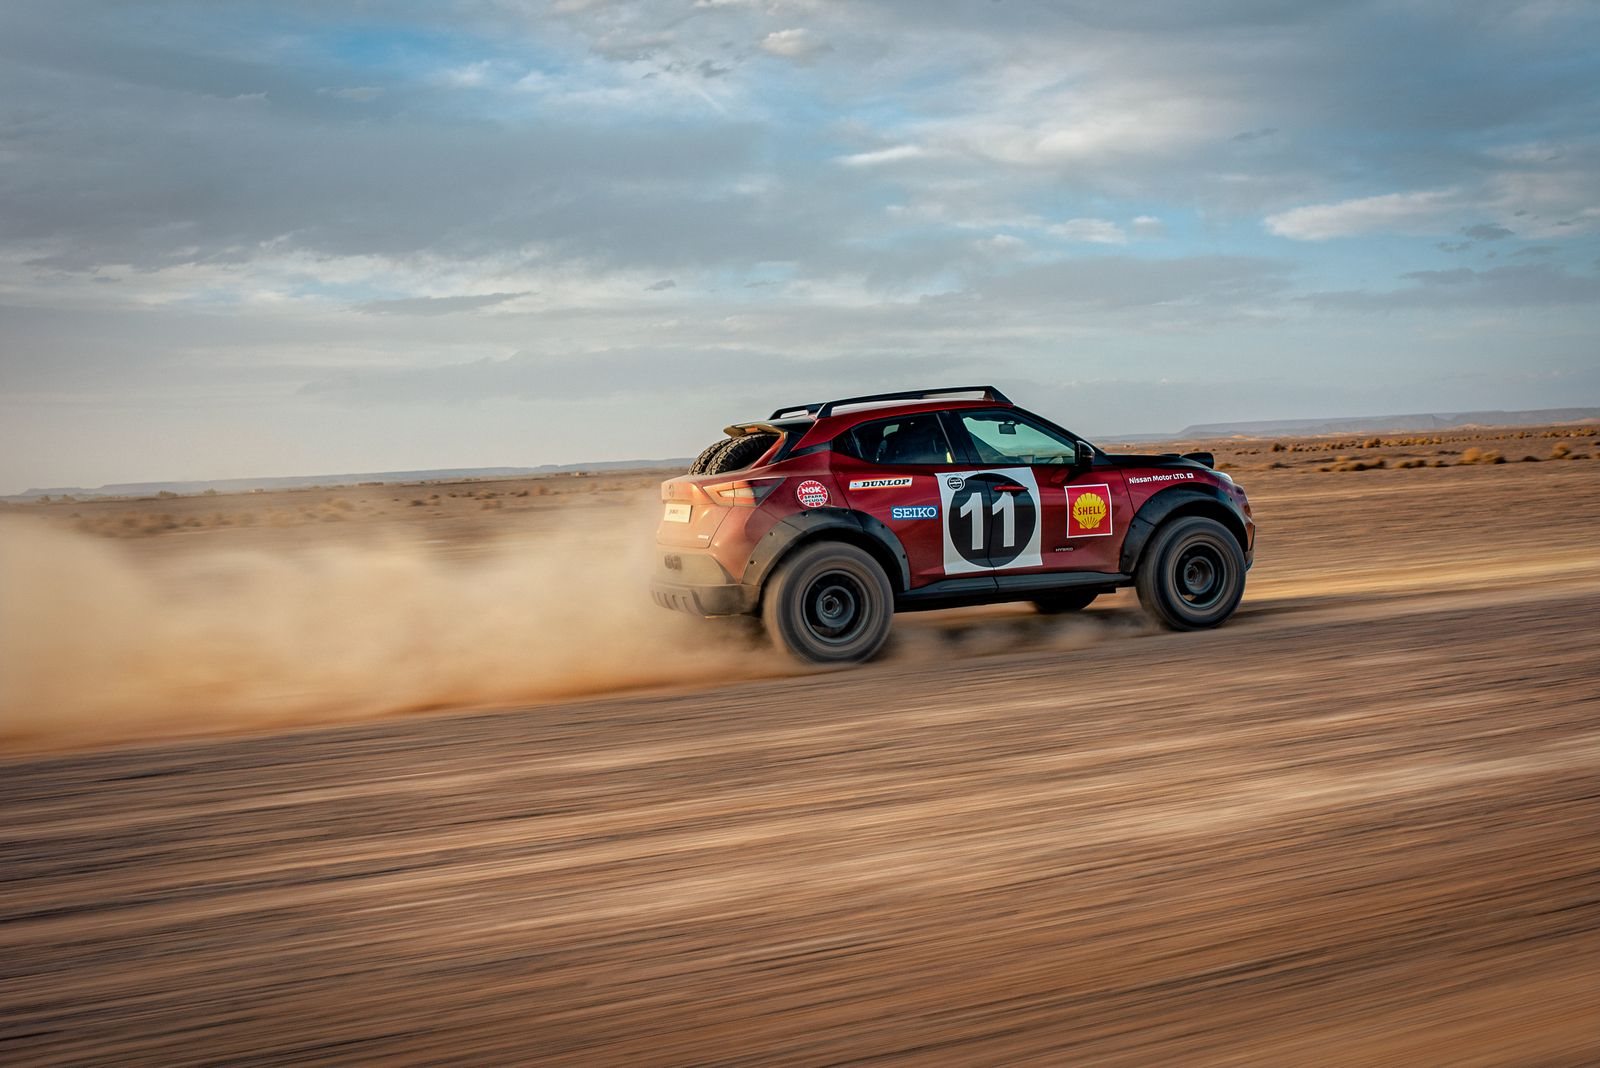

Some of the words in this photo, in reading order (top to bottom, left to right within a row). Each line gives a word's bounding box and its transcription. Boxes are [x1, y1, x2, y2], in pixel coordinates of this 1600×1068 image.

[862, 478, 910, 487] DUNLOP
[893, 507, 937, 519] SEIKO
[1077, 506, 1102, 516] SHELL
[960, 491, 1015, 551] 11
